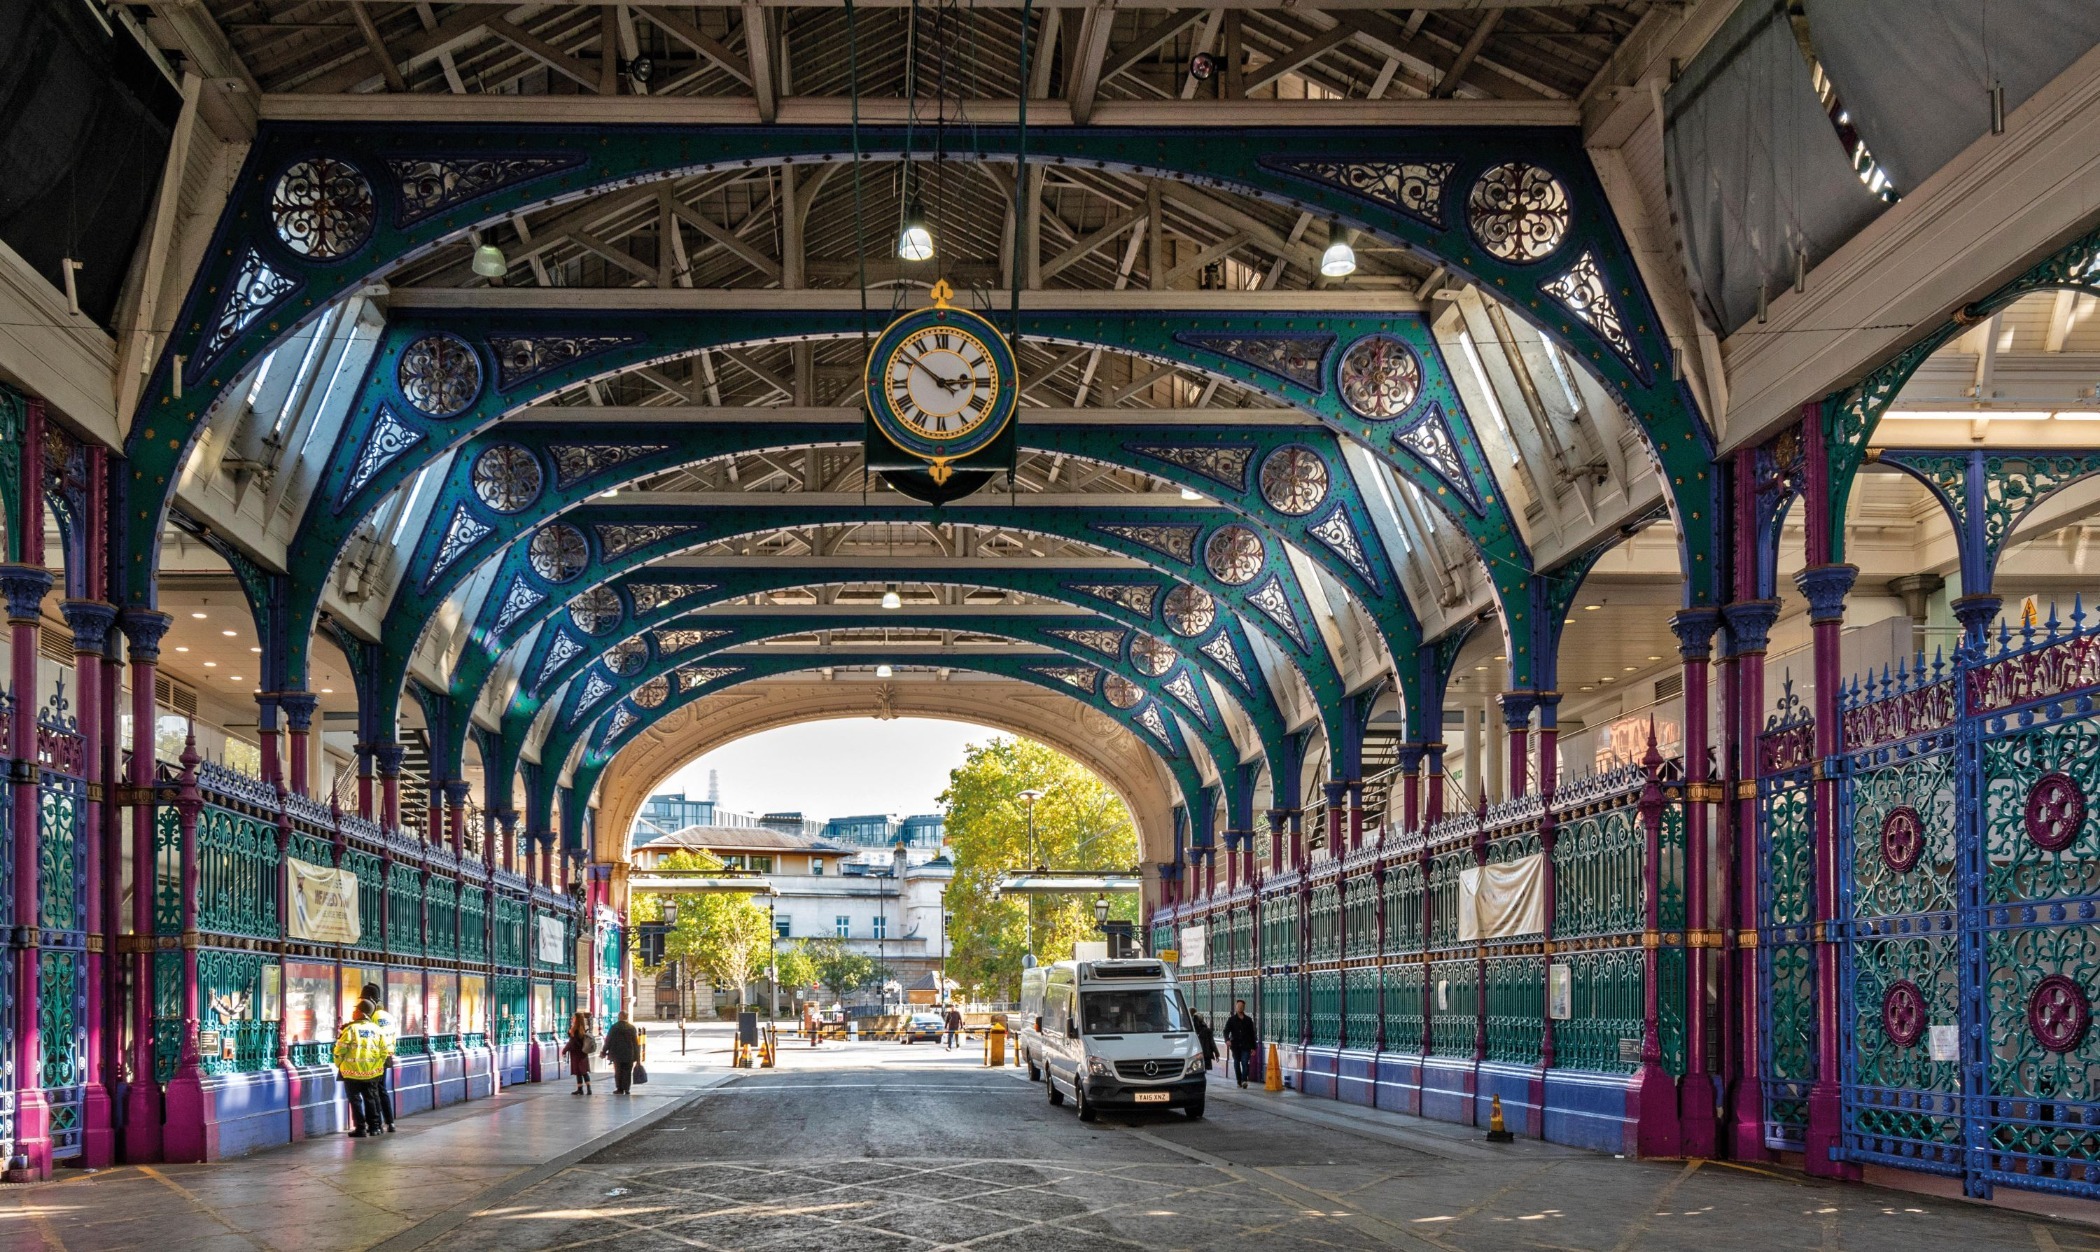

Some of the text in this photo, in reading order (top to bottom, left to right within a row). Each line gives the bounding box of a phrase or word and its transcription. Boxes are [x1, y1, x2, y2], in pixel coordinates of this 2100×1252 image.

[913, 339, 928, 355] XI
[935, 334, 949, 349] XII
[958, 340, 967, 353] I
[970, 355, 986, 368] II
[975, 377, 991, 388] III
[896, 394, 914, 414] VIII
[912, 410, 928, 428] VII
[936, 416, 947, 431] VI
